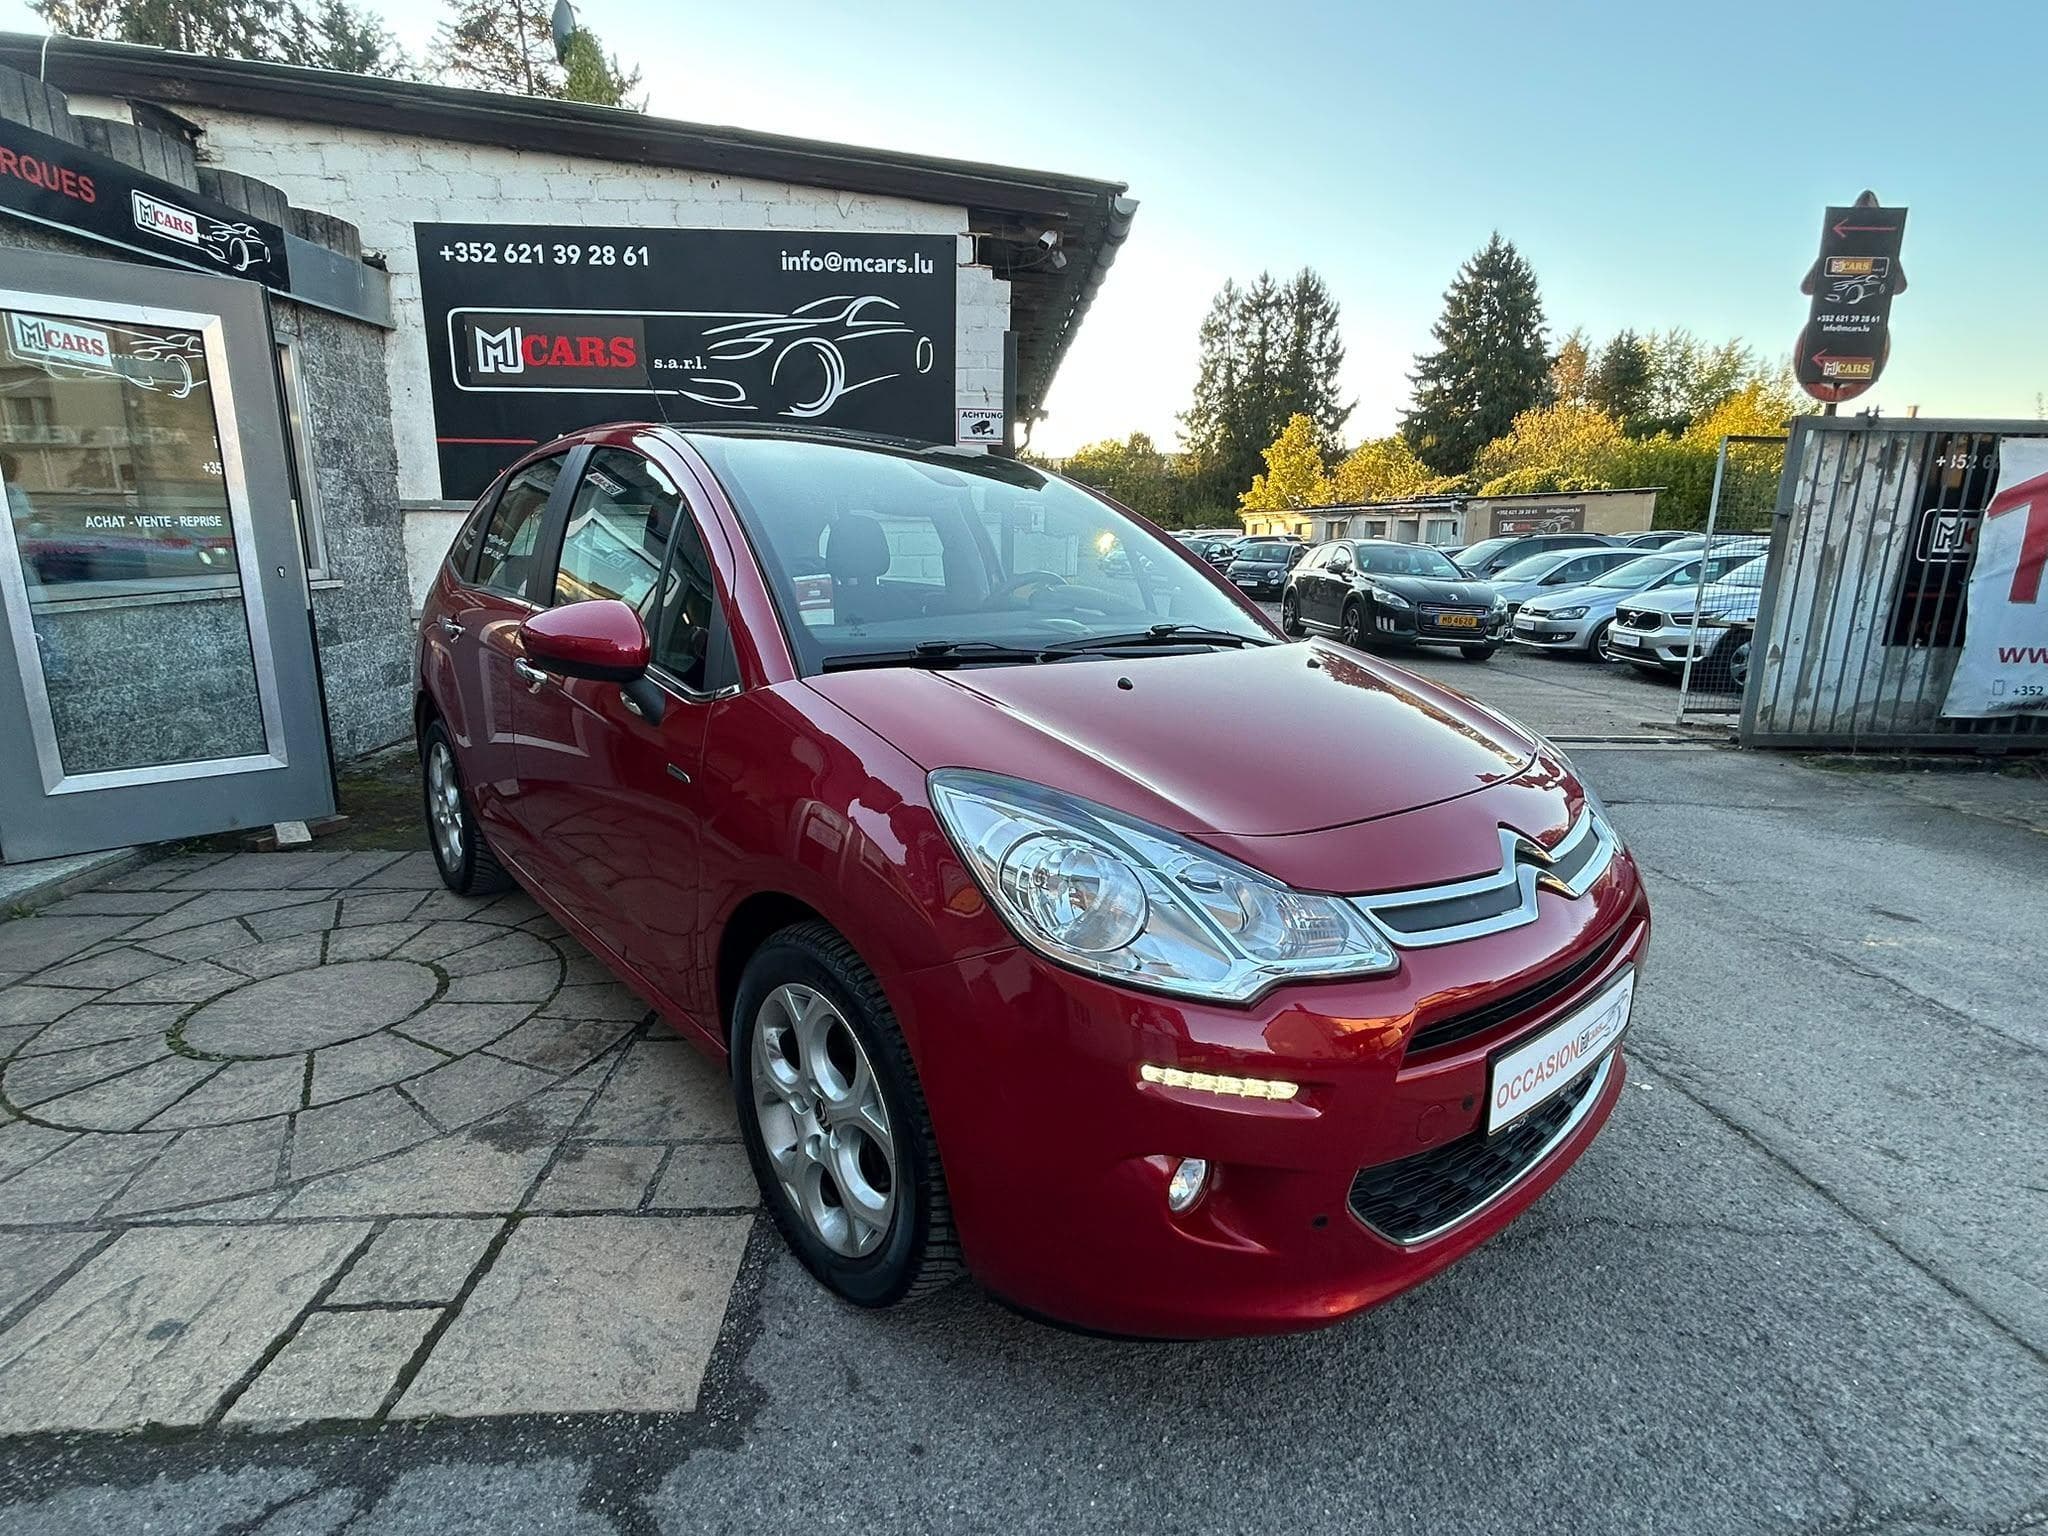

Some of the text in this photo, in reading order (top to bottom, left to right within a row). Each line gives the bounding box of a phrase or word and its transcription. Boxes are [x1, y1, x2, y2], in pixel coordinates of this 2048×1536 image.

[439, 242, 649, 266] +352 621 39 28 61
[781, 250, 934, 274] info@mcars.lu
[654, 355, 707, 370] s.a.r.l.
[961, 411, 1003, 419] ACHTUNG
[86, 515, 126, 528] ACHAT
[135, 515, 172, 528] VENTE
[180, 515, 223, 527] REPRISE
[2012, 685, 2044, 696] +352
[1497, 1038, 1580, 1109] OCCASION
